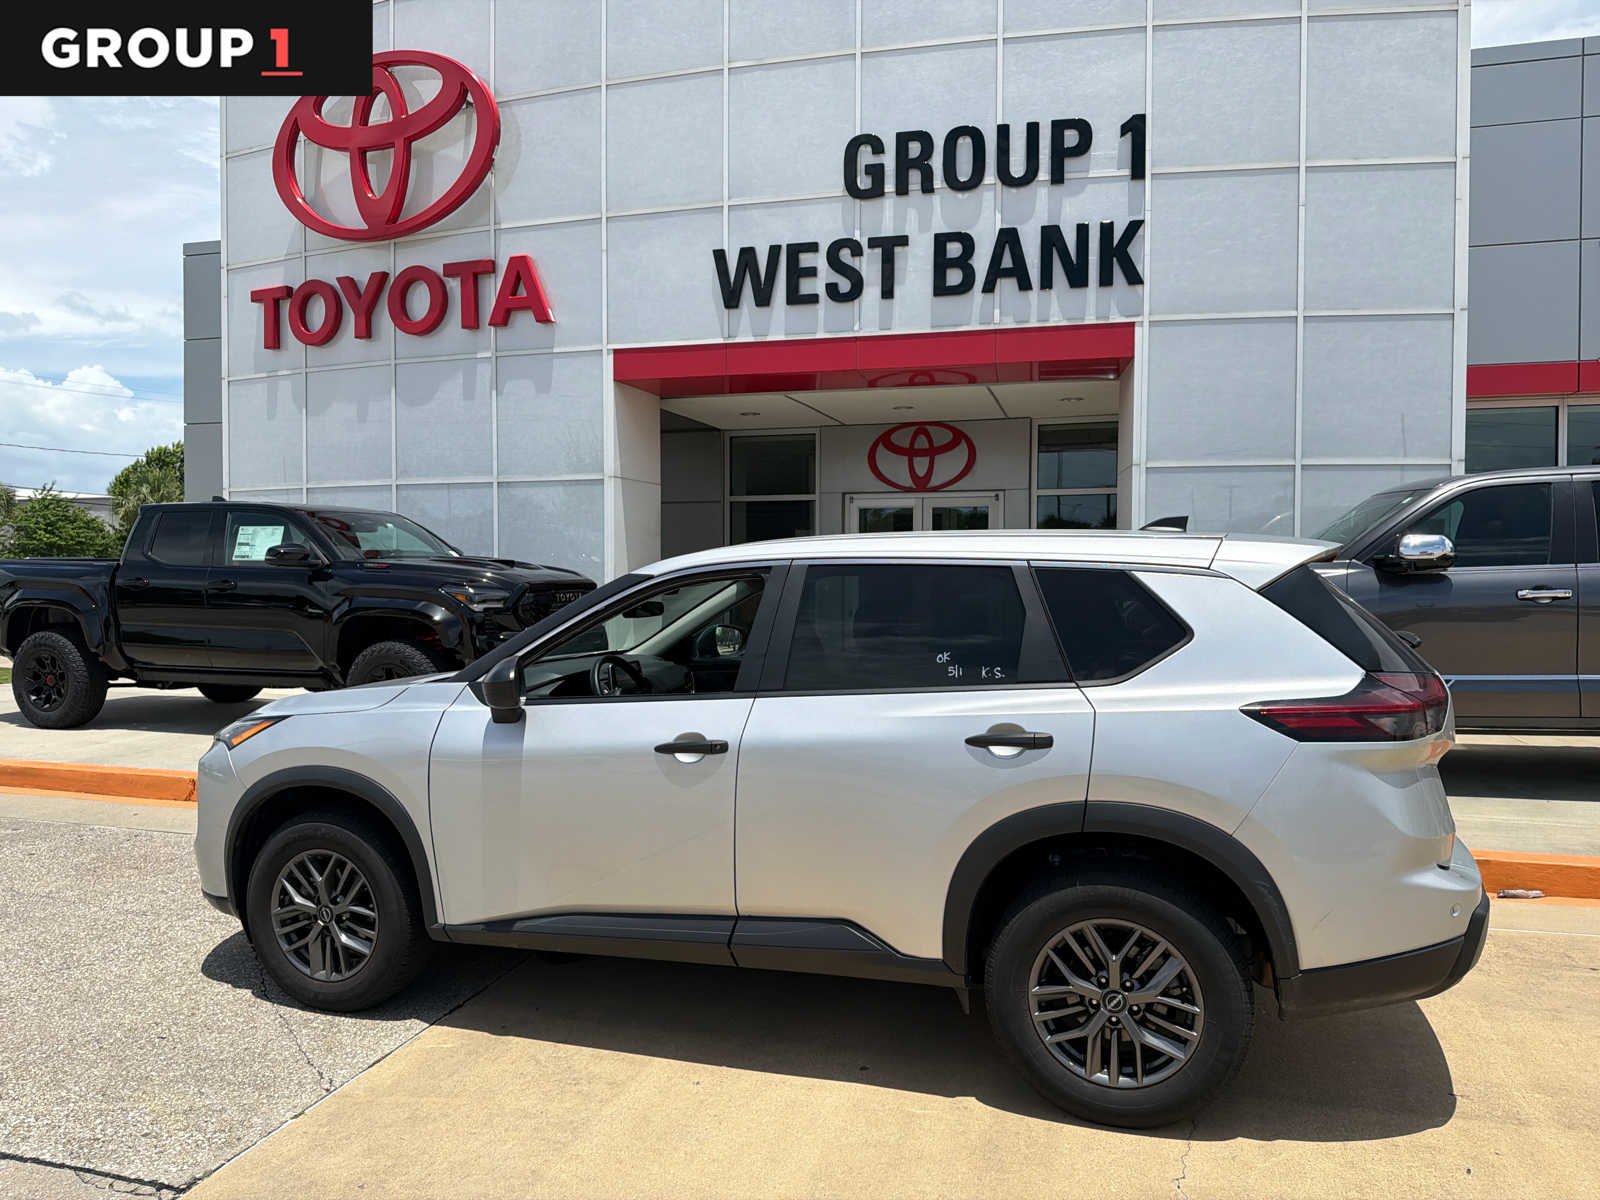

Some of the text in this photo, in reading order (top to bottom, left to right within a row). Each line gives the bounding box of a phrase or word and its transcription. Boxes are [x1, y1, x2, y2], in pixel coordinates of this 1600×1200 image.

[844, 114, 1146, 200] GROUP 1
[251, 254, 555, 349] TOYOTA
[713, 219, 1145, 309] WEST BANK
